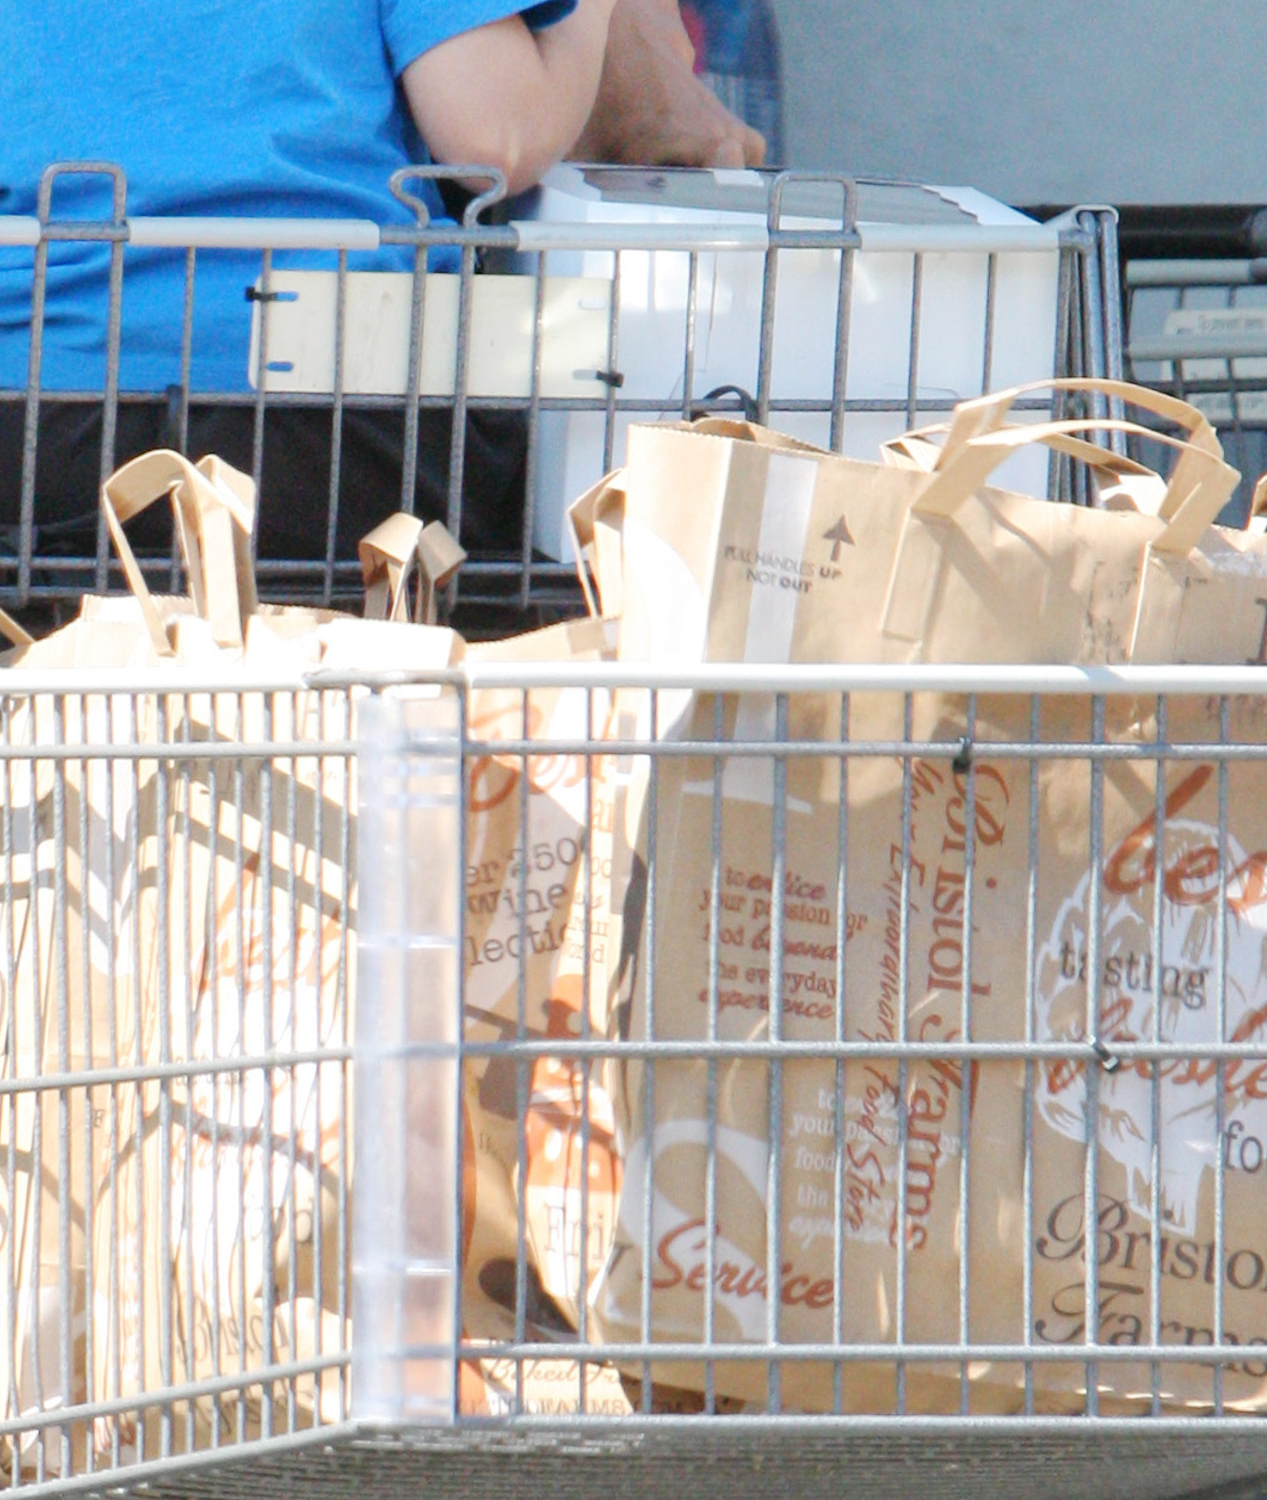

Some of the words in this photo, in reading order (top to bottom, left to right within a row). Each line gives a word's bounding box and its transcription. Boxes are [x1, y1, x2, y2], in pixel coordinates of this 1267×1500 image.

[779, 576, 813, 593] OUT
[927, 762, 1009, 997] Bristol
[698, 889, 747, 913] yur
[702, 923, 745, 947] fod
[706, 959, 739, 981] he
[745, 966, 838, 1000] evryday
[788, 1113, 840, 1137] you
[1036, 1191, 1267, 1291] Bristo
[641, 1218, 837, 1310] Service
